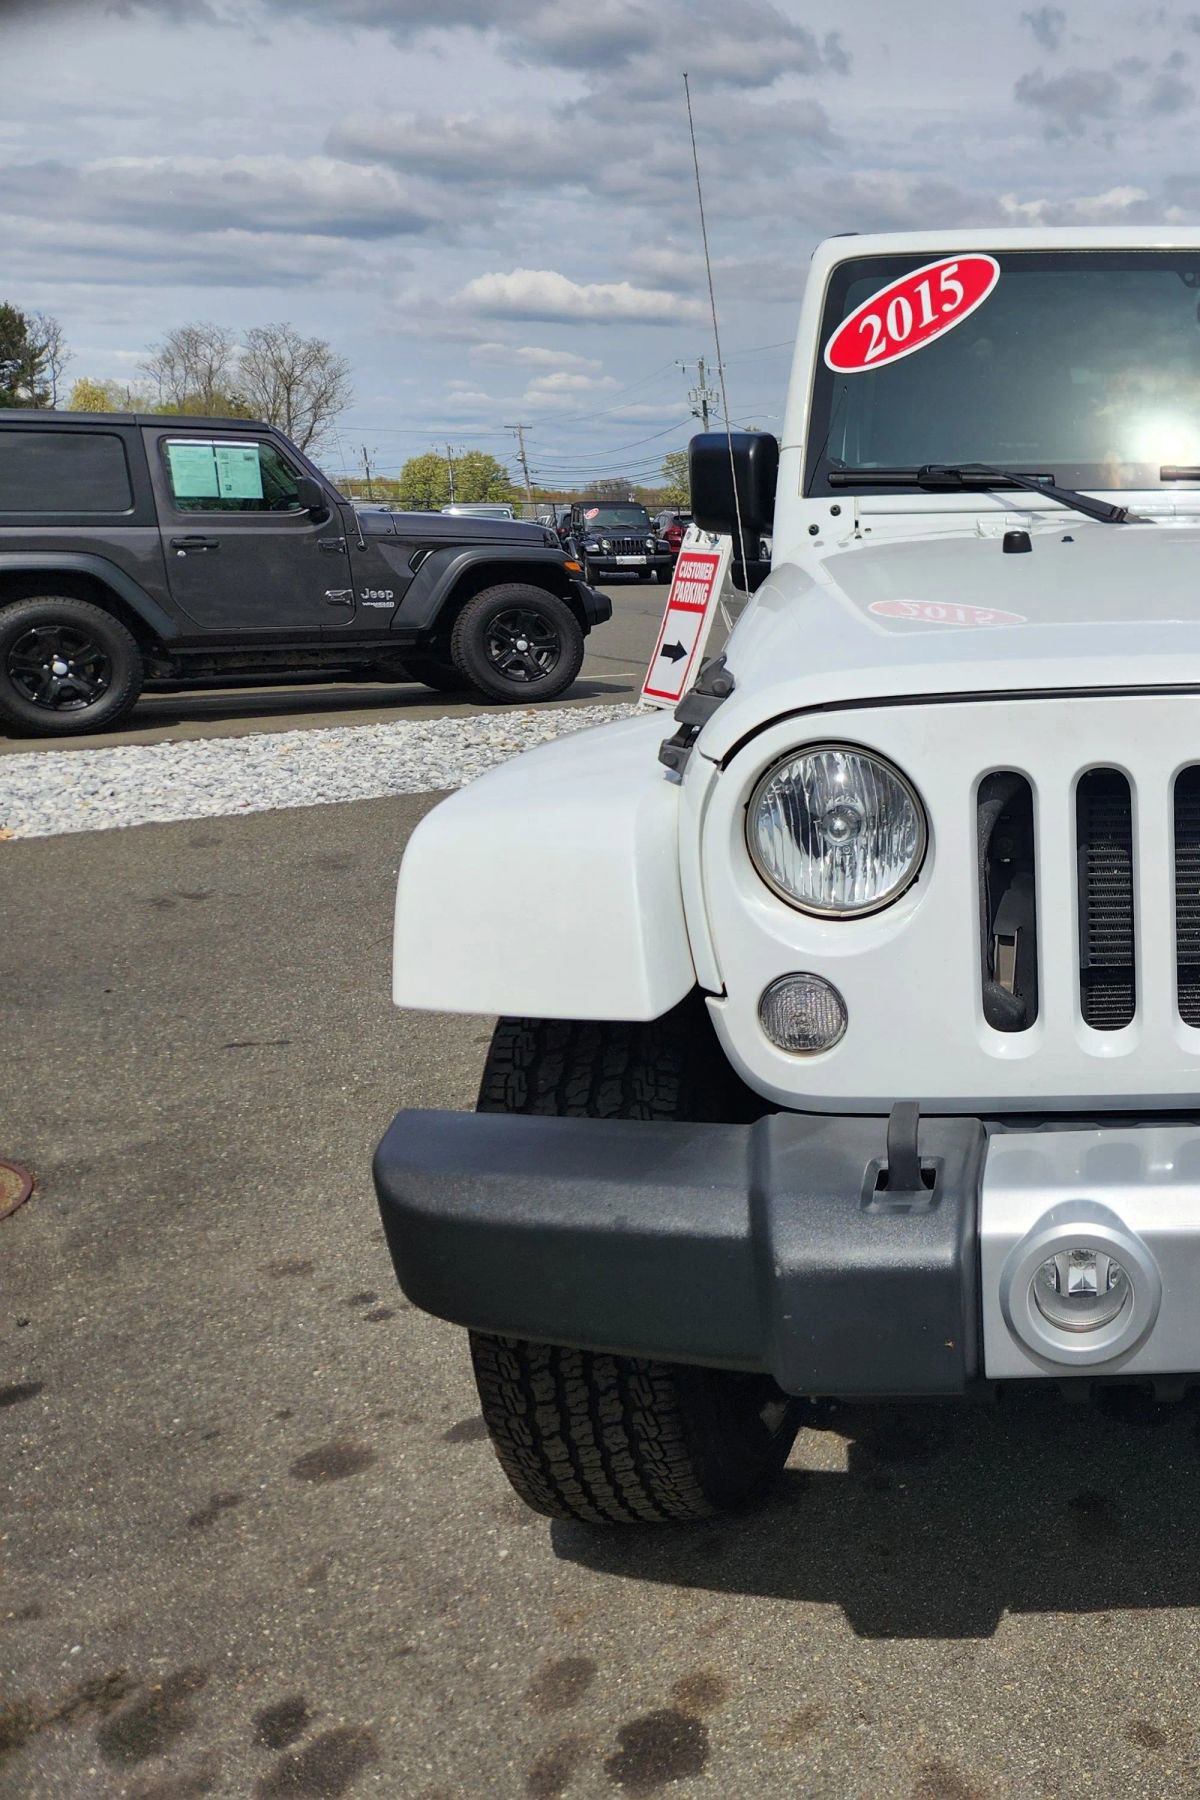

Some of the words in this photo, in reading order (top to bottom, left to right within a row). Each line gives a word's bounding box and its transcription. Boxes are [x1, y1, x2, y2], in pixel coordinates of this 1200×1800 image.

[858, 263, 965, 363] 2015
[678, 560, 715, 581] CUSTOMER
[360, 587, 394, 601] Jeep
[672, 580, 710, 606] PARKING
